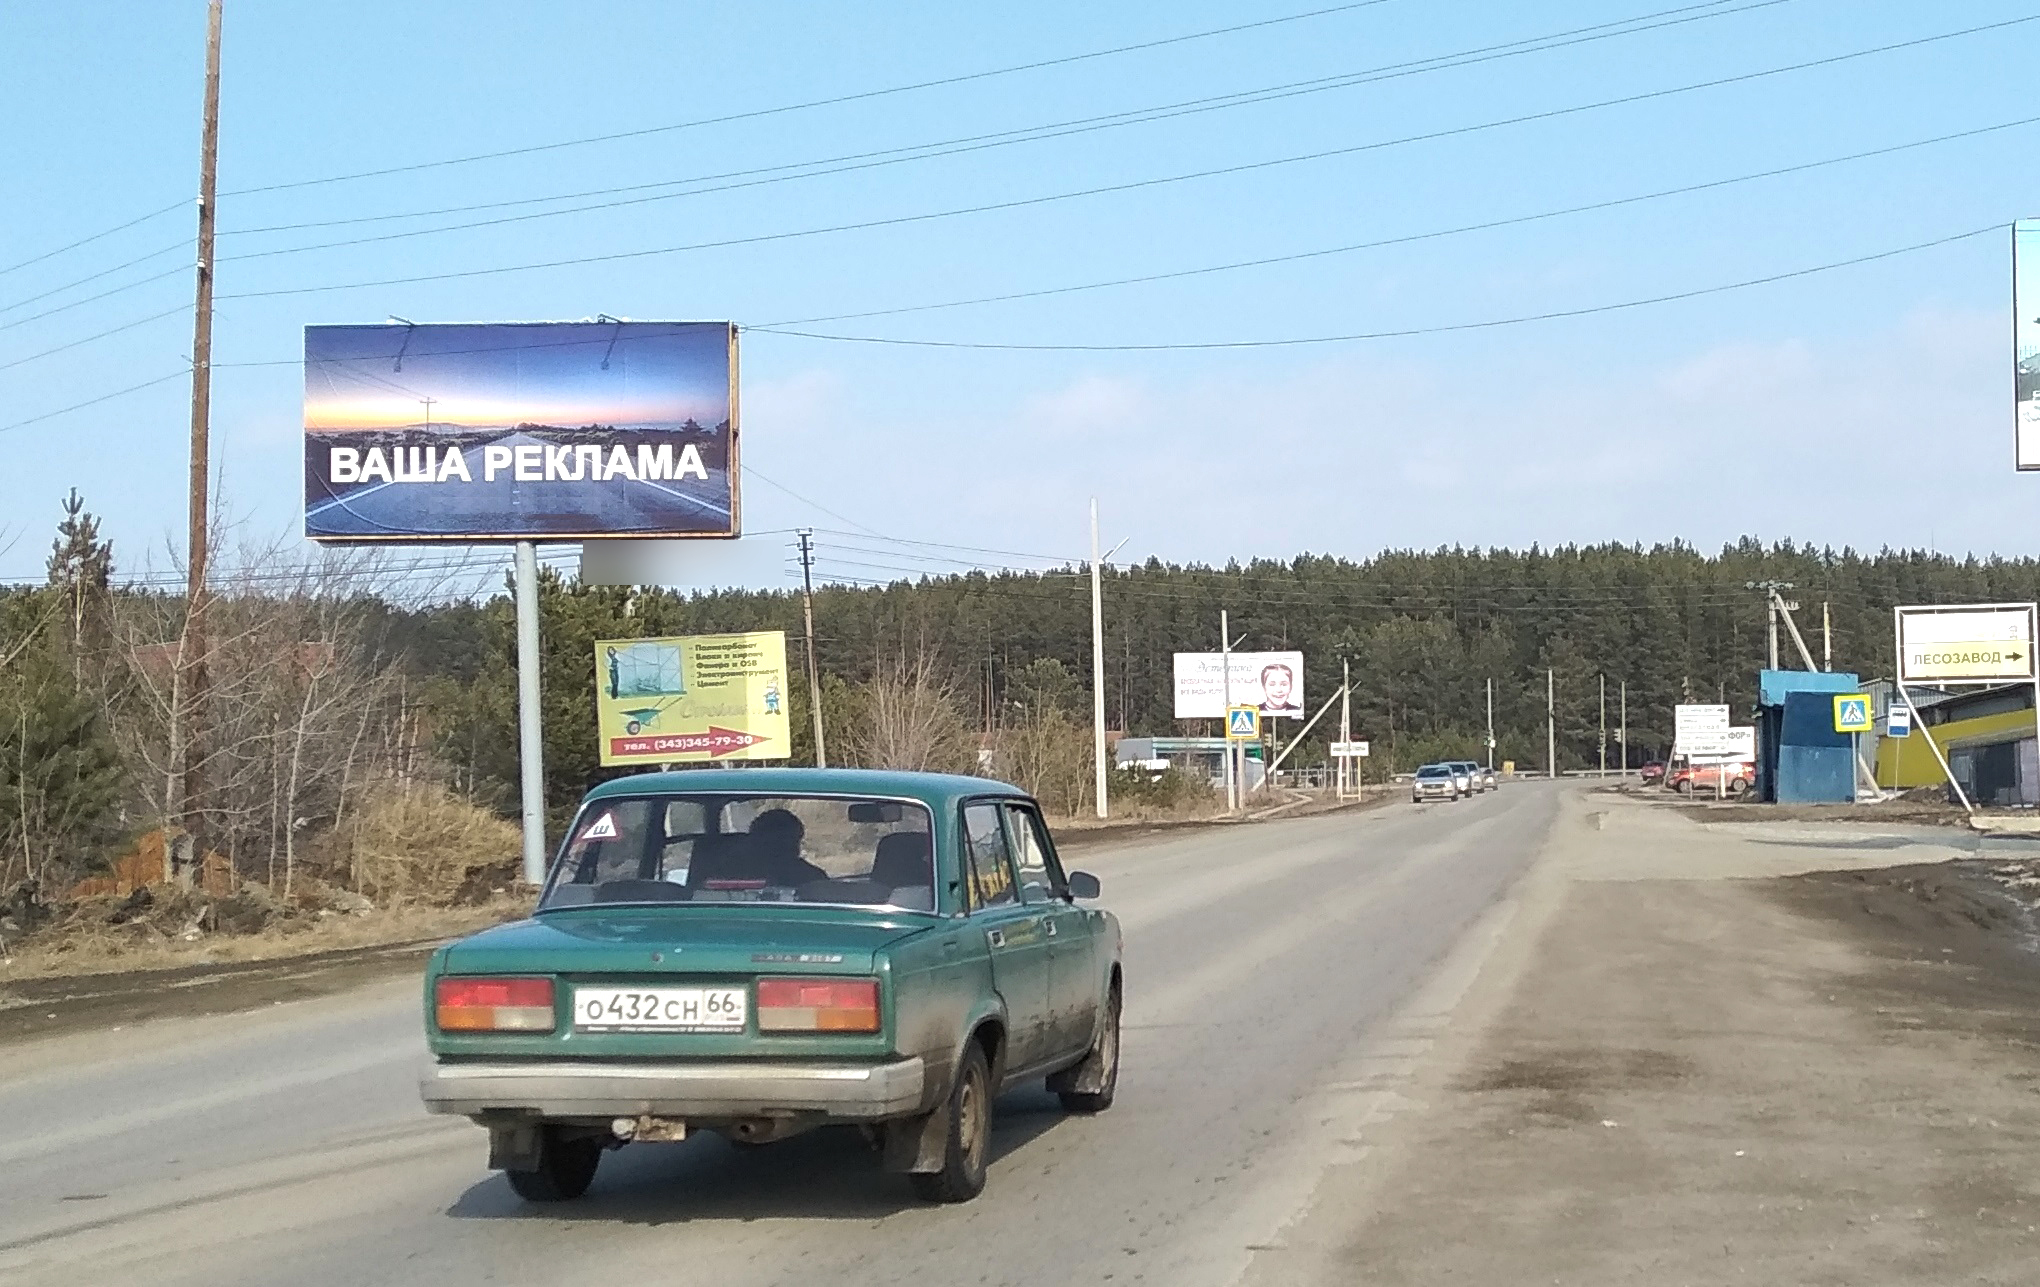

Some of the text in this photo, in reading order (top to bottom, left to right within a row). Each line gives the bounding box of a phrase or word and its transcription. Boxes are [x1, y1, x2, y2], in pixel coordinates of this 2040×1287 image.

[330, 443, 709, 483] ВАША РЕКЛАМА
[1914, 652, 2002, 666] ЛЕСОЗАВОД
[623, 734, 753, 751] тел. (343)345-79-30
[592, 824, 610, 836] Ш
[707, 992, 736, 1013] 66
